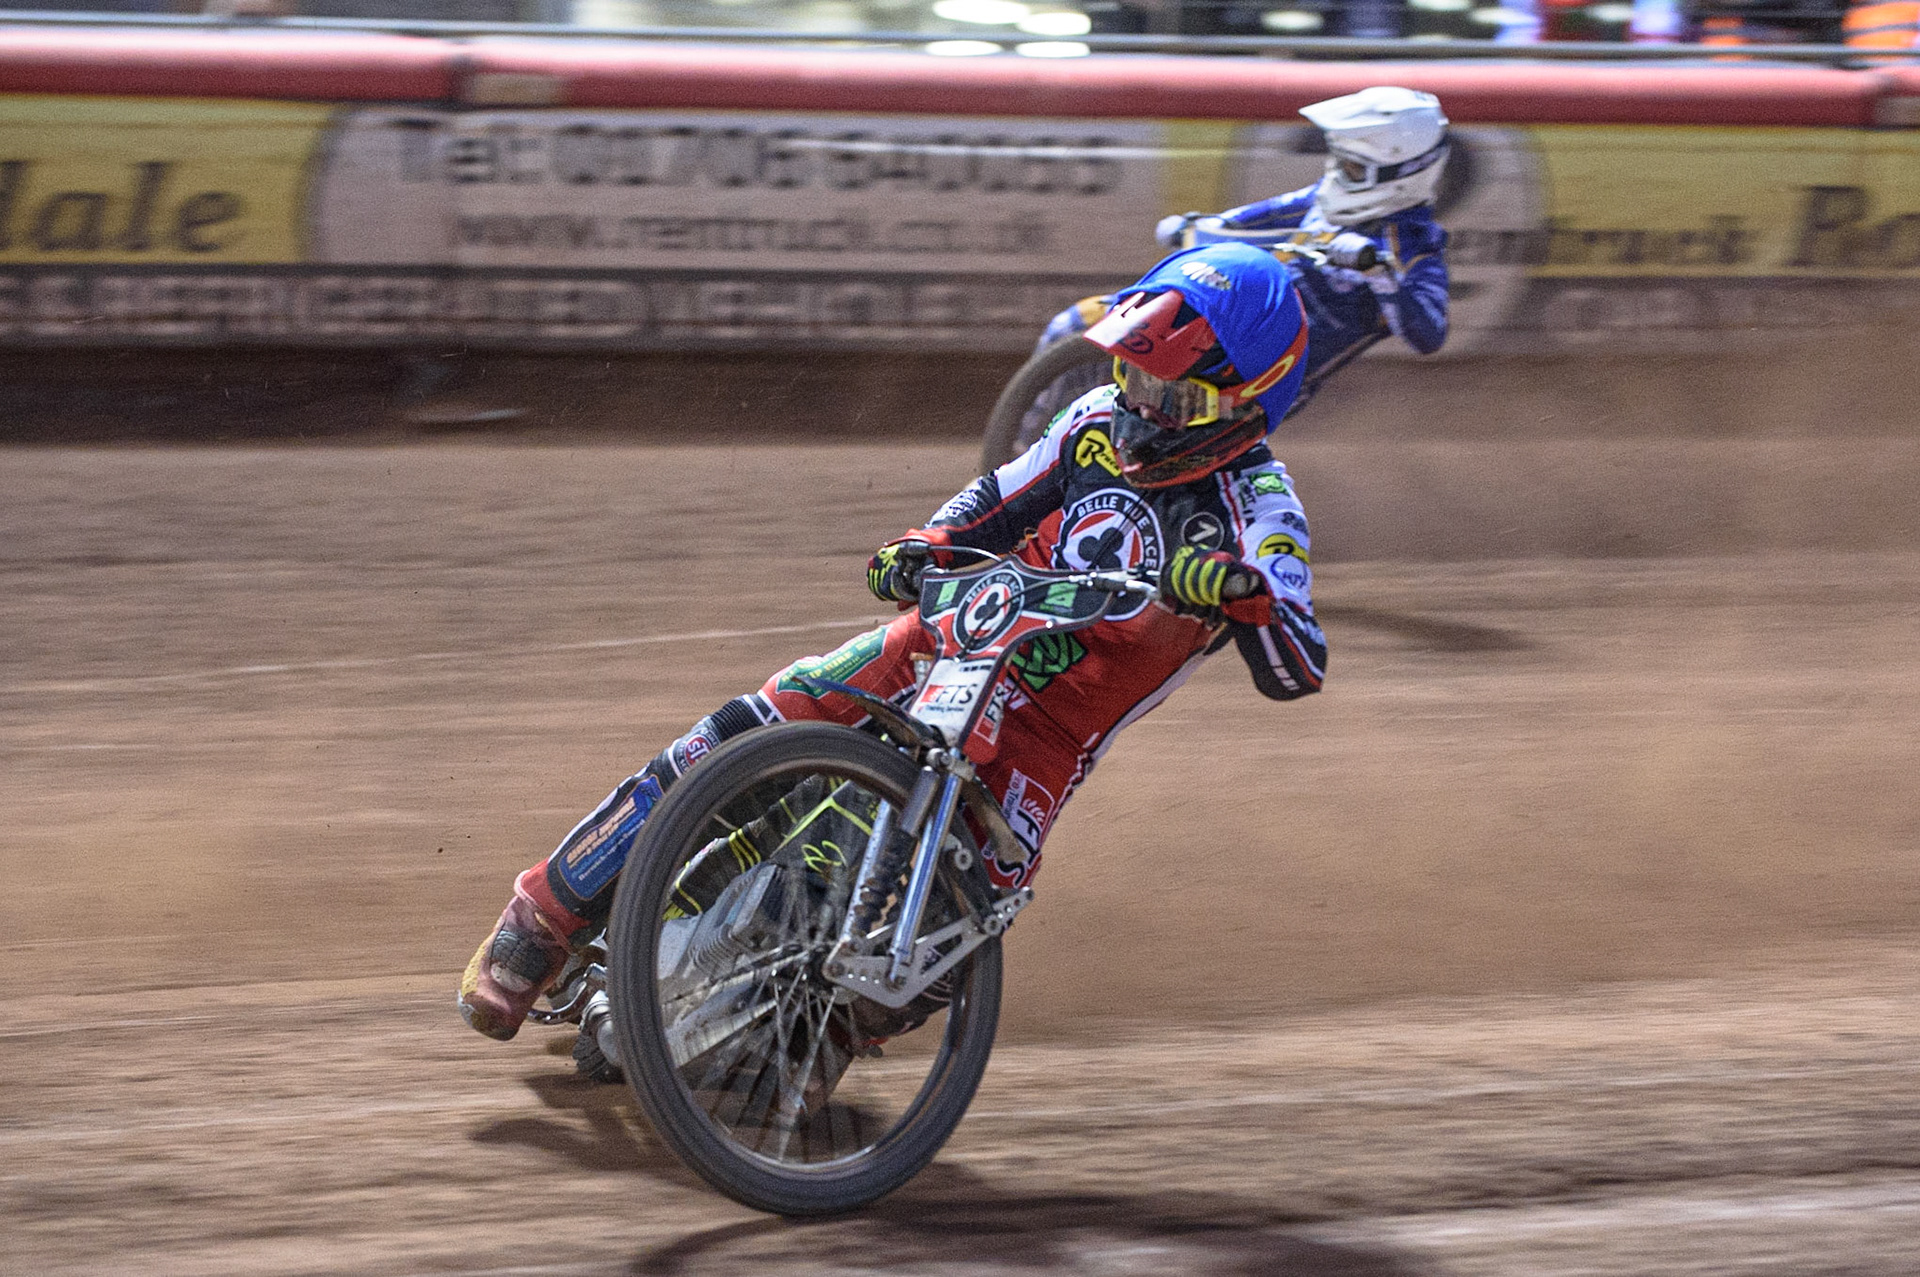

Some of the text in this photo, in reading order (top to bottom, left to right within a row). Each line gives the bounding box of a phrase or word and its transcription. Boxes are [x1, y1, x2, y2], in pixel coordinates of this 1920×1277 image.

[1077, 496, 1158, 569] BELLE VUE ACE
